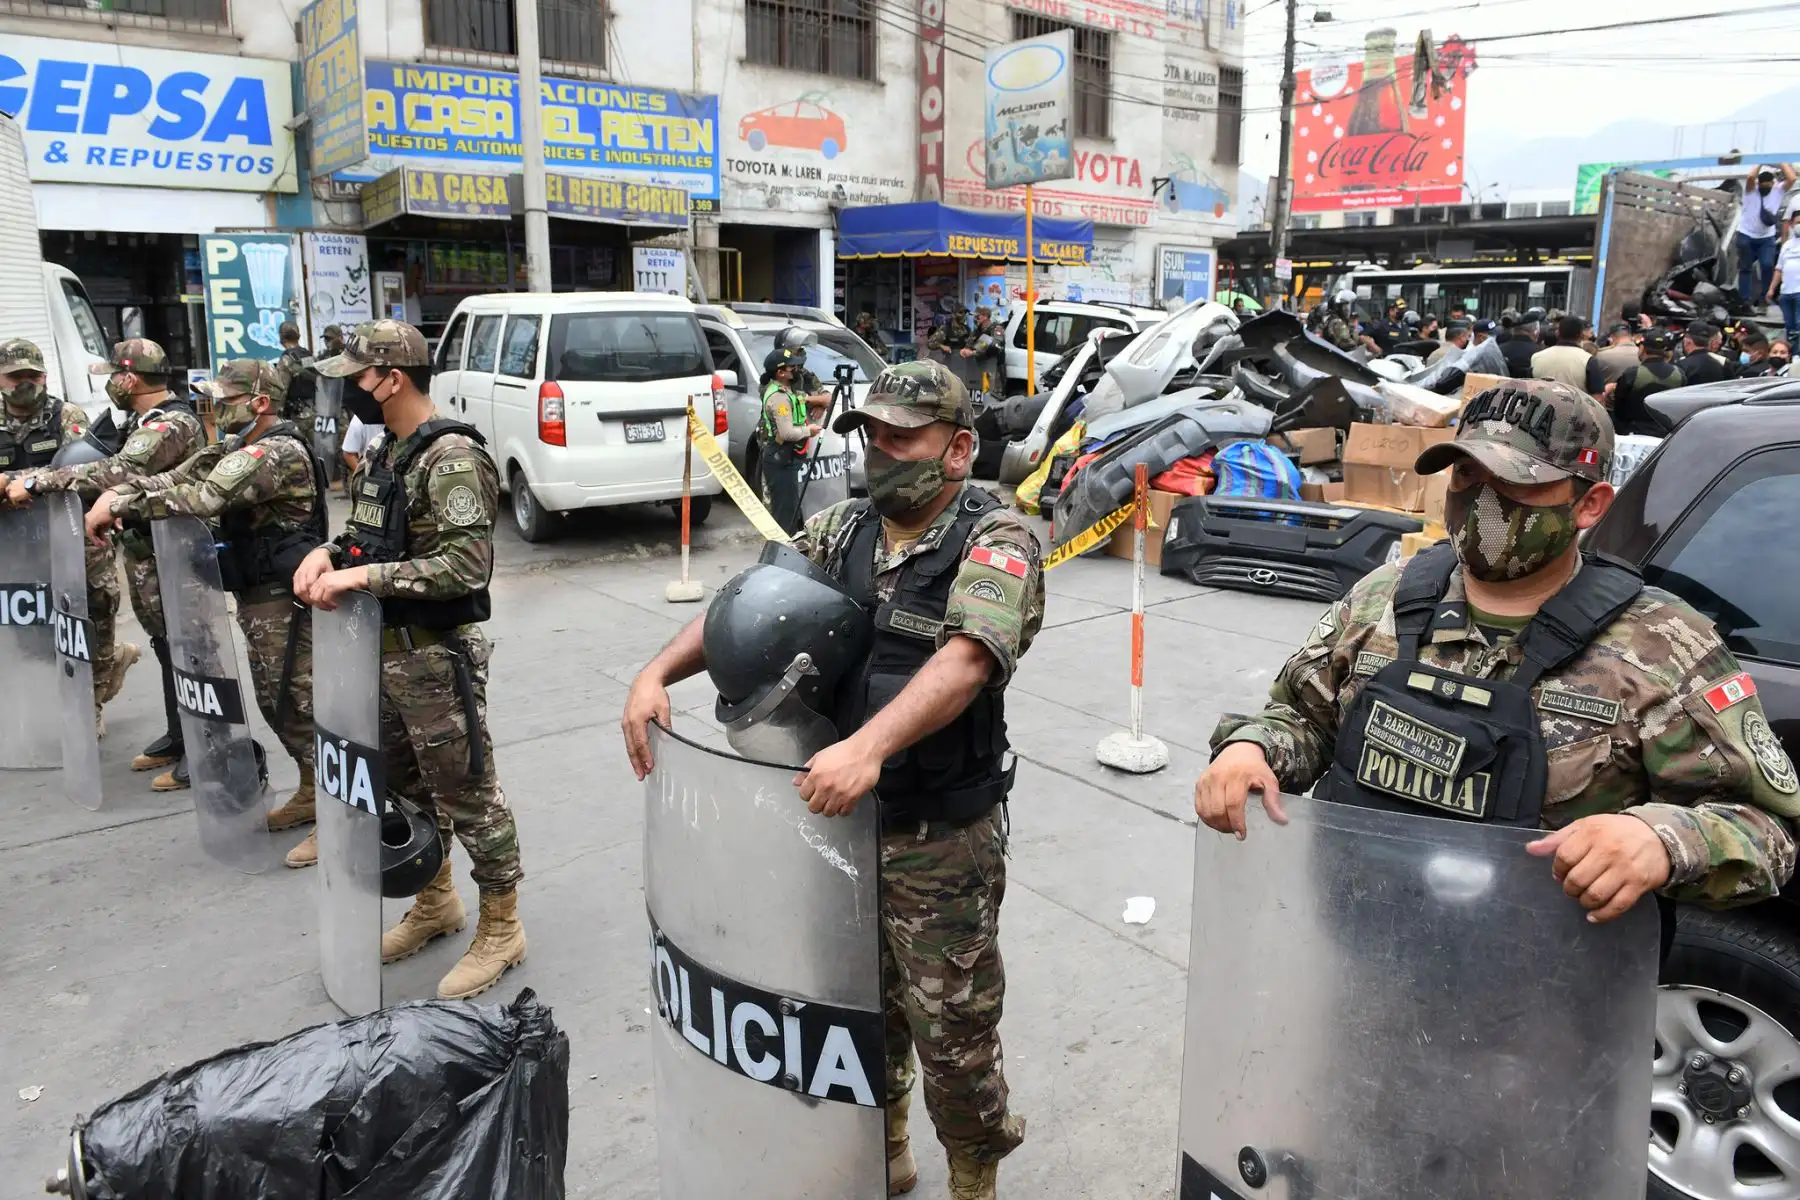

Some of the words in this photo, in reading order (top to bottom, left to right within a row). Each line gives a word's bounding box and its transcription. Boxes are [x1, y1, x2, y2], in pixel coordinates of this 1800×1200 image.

[1084, 8, 1156, 40] PARTS
[393, 66, 668, 112] IMPORACIONES
[997, 100, 1056, 116] McLaren
[403, 92, 514, 139] CASA
[601, 109, 714, 154] RETEN
[44, 140, 69, 164] &
[86, 146, 275, 174] REPUESTOS
[590, 148, 600, 161] E
[606, 149, 713, 169] INDUSTRIALES
[727, 158, 777, 176] TOYOTA
[781, 166, 793, 176] Mc
[795, 167, 822, 181] LAREN
[408, 171, 438, 200] LA
[443, 173, 509, 205] CASA
[569, 177, 622, 210] RETEN
[1080, 205, 1148, 225] SERVICIO
[322, 235, 343, 243] CASA
[949, 235, 1018, 254] REPUESTOS
[647, 258, 675, 267] RETEN
[1164, 252, 1185, 271] SUN
[1574, 699, 1614, 718] NACIONAL
[1368, 724, 1406, 750] SUBOFICIAL
[1409, 745, 1426, 759] 3RA
[1431, 753, 1451, 770] 2014
[1384, 714, 1445, 752] BARRANTES
[1446, 741, 1456, 760] D.
